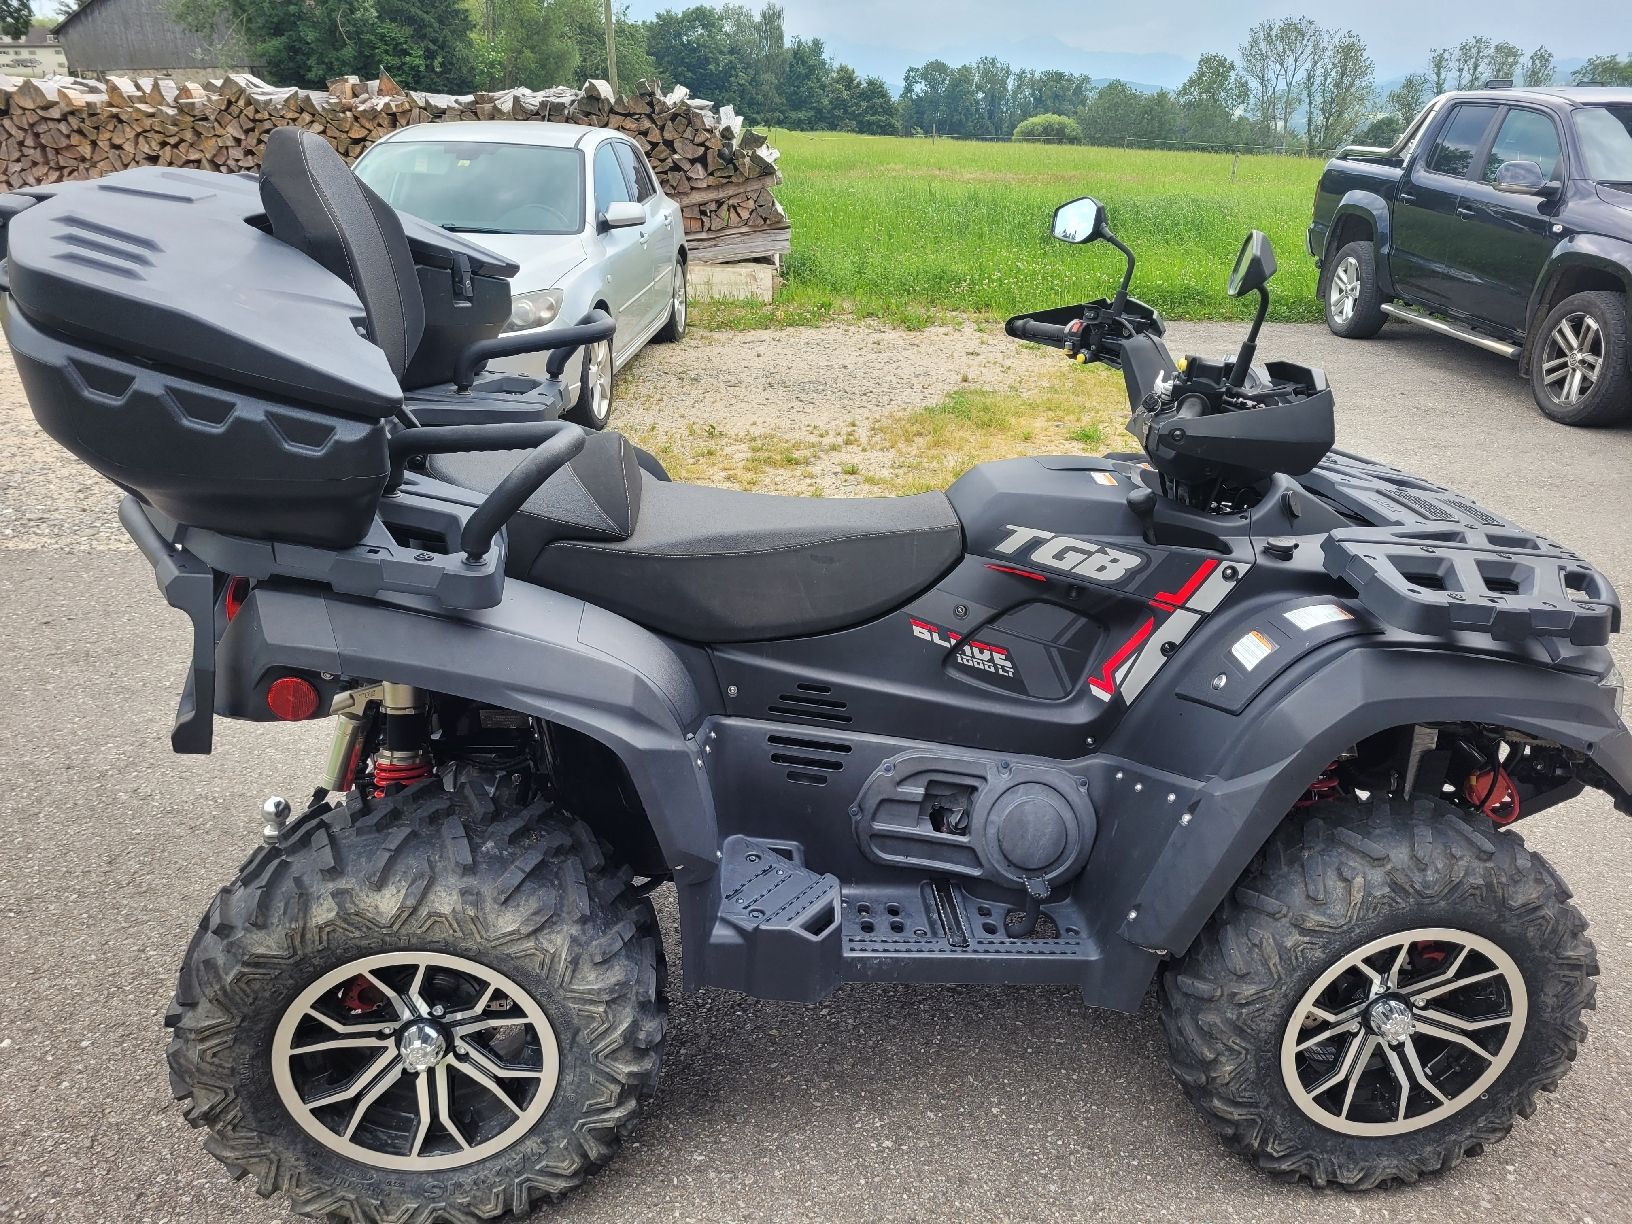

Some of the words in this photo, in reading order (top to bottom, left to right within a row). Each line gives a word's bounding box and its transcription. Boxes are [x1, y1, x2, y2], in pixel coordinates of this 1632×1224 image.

[994, 524, 1142, 581] TGB
[956, 650, 996, 673] 1000
[996, 664, 1014, 678] LT
